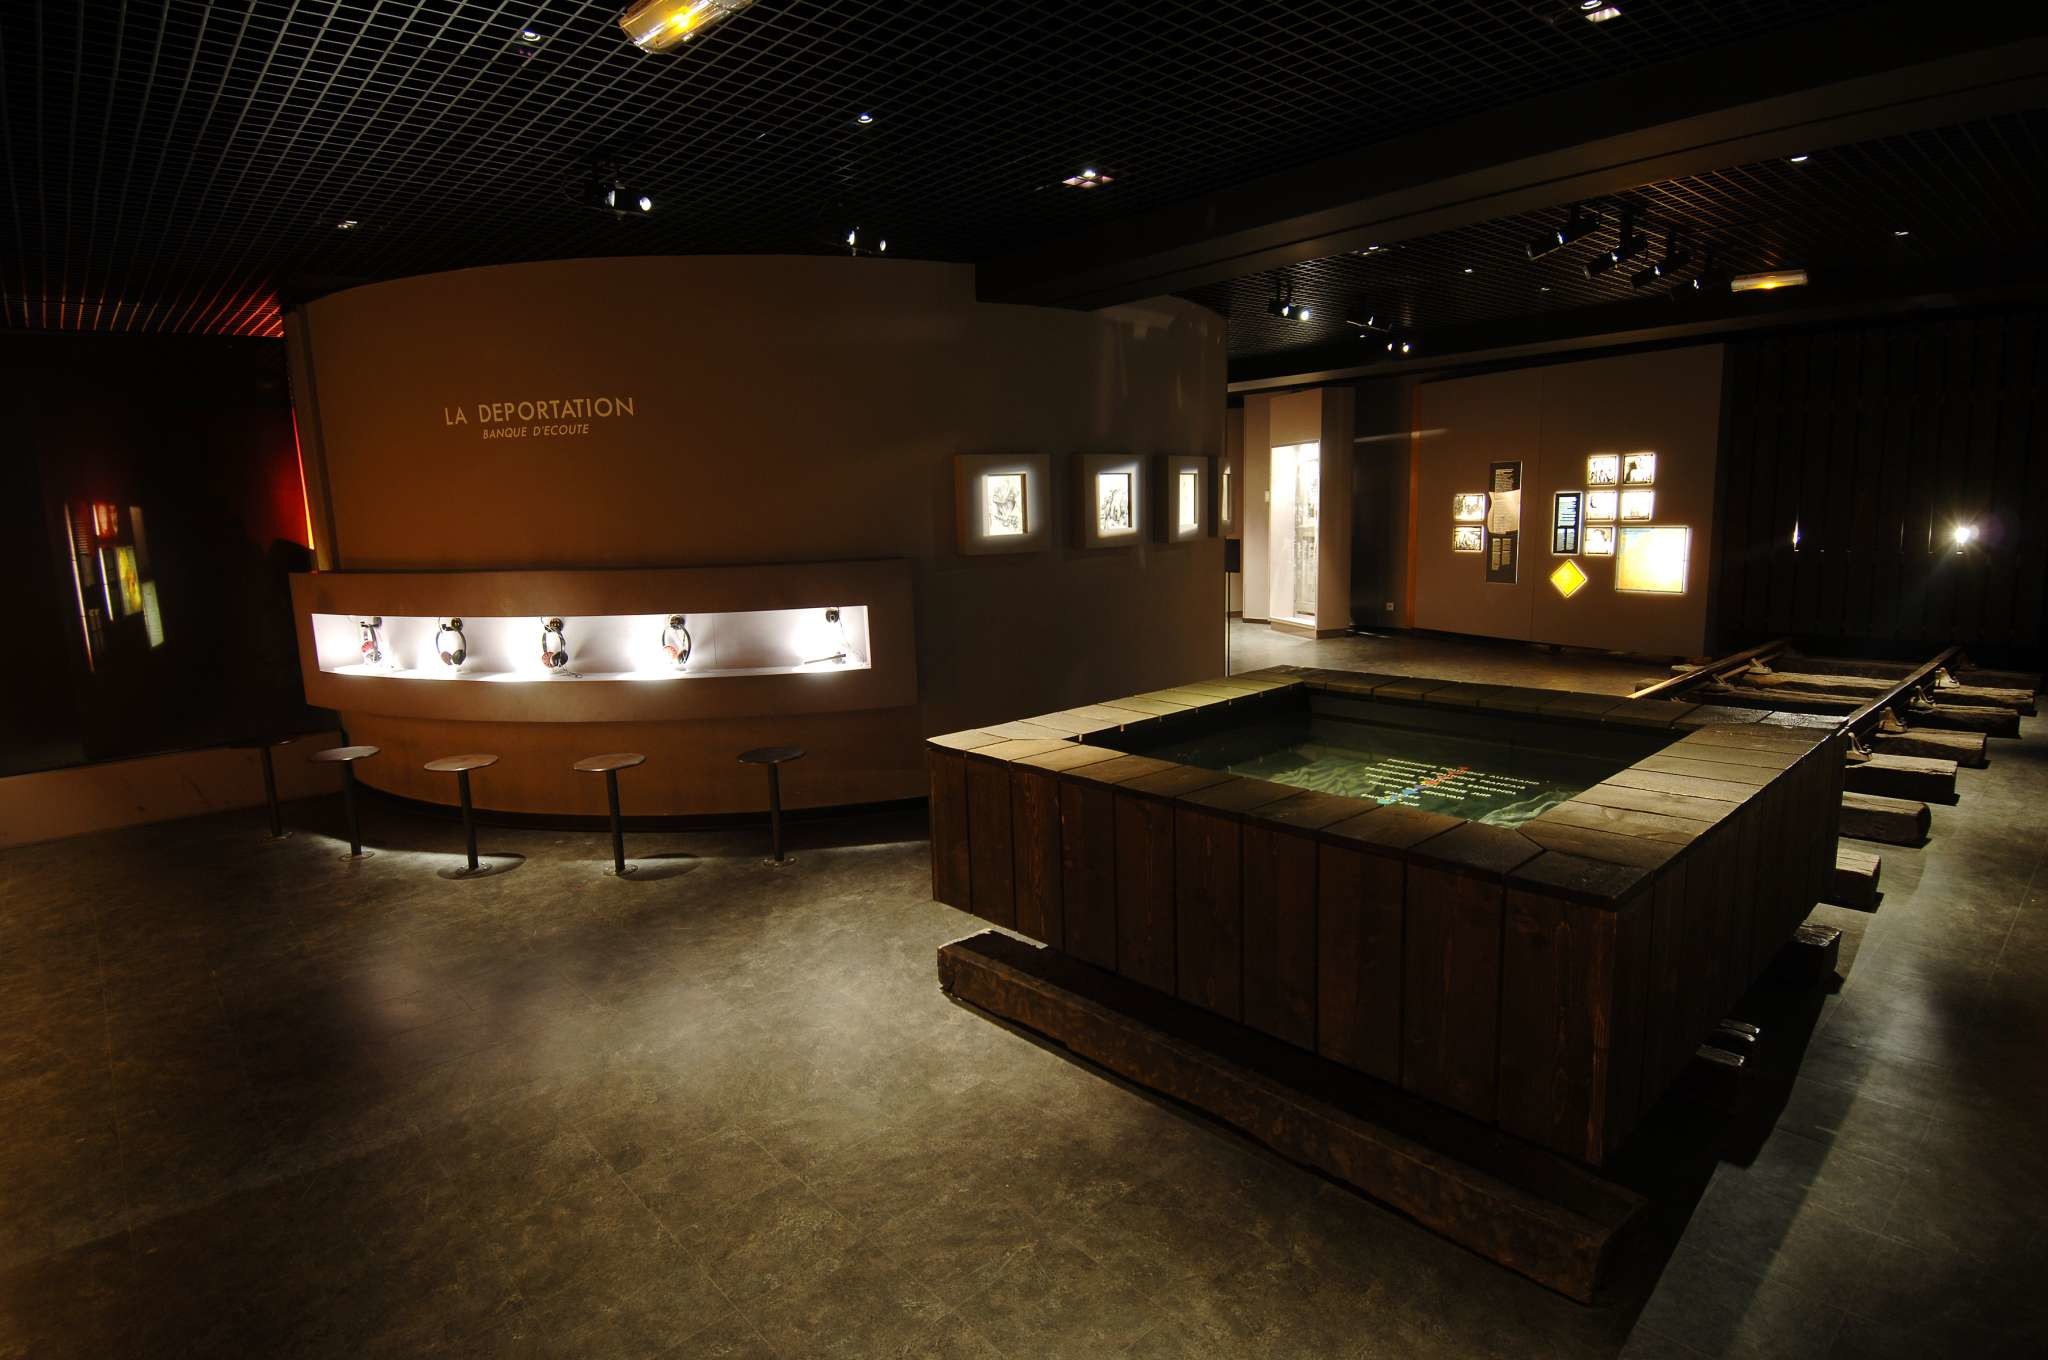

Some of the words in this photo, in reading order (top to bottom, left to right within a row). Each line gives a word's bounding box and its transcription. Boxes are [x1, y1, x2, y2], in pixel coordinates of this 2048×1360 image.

[444, 407, 468, 425] LA
[478, 397, 634, 423] DEPORTATION
[482, 426, 528, 440] BANQUE
[533, 423, 590, 437] D'ECOUTE
